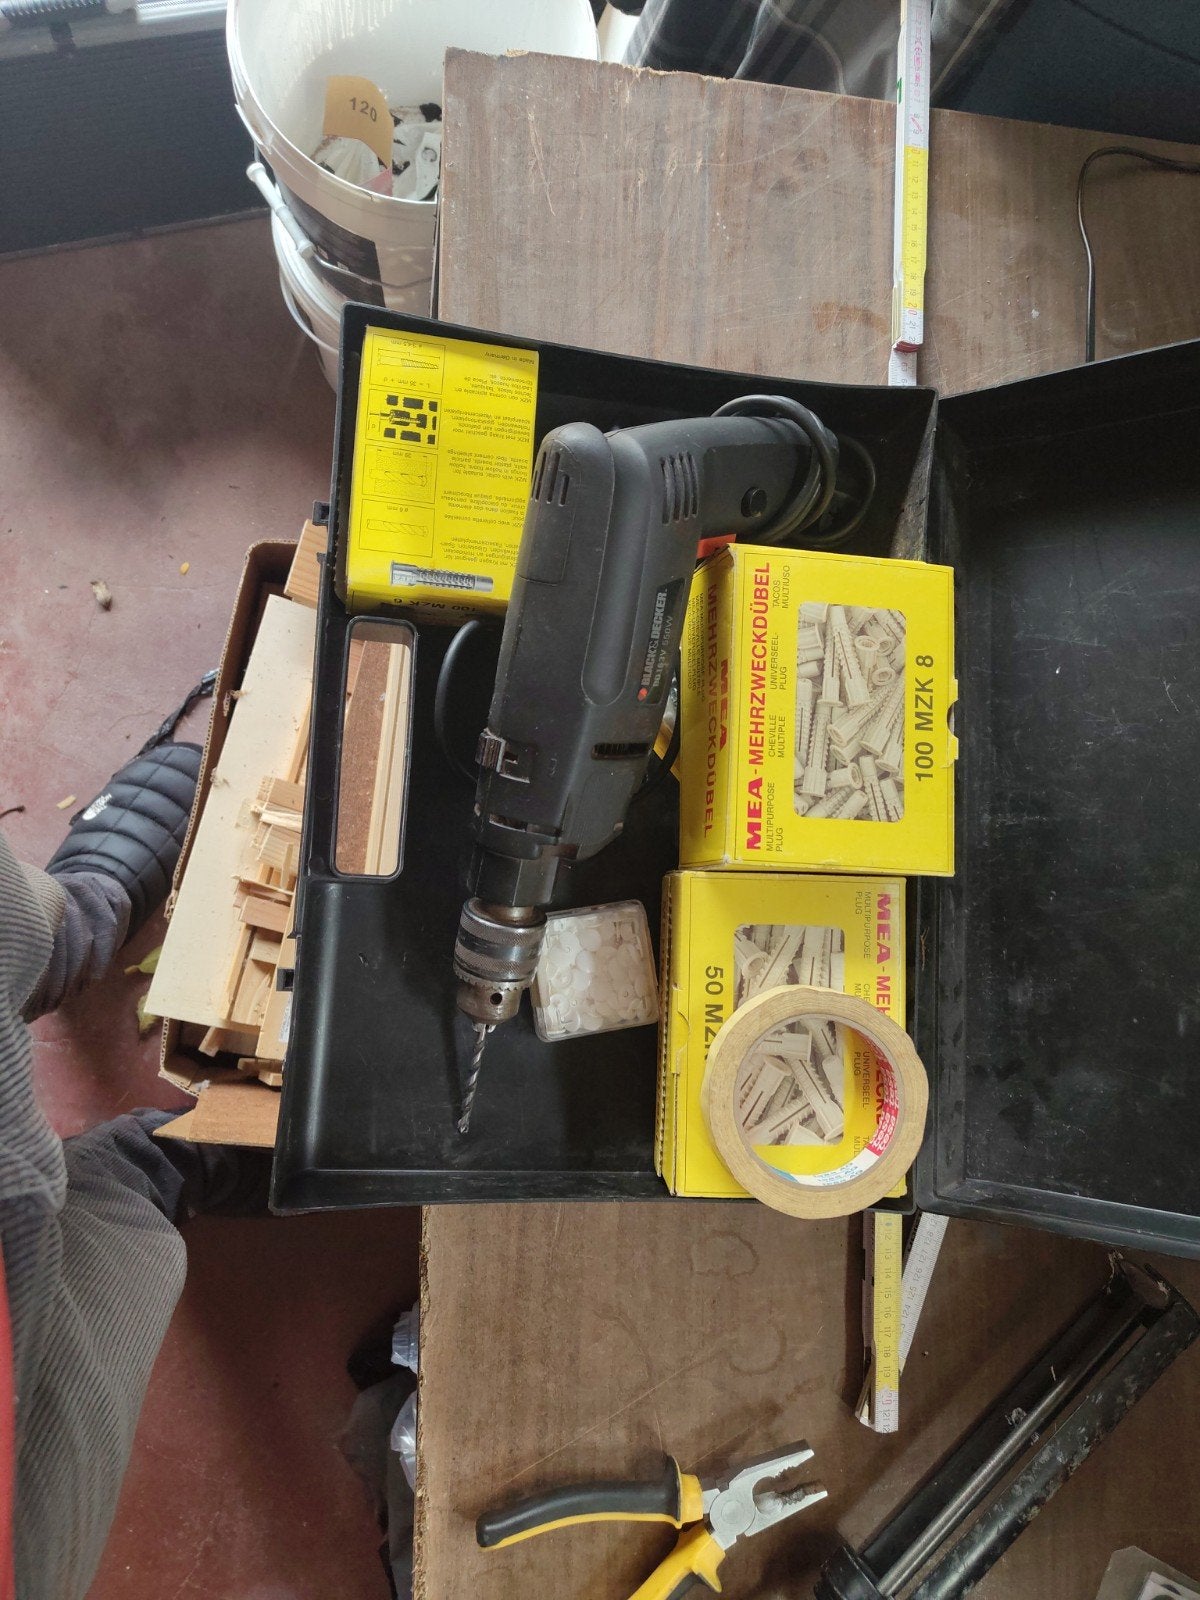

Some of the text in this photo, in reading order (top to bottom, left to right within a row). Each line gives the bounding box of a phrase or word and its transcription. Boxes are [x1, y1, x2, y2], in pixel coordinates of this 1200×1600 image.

[349, 97, 377, 122] 120
[912, 176, 919, 184] 12
[912, 192, 918, 200] 13
[912, 208, 918, 216] 14
[911, 224, 918, 232] 15
[910, 240, 918, 248] 16
[910, 272, 918, 281] 18
[910, 288, 917, 297] 19
[908, 302, 918, 316] 20
[484, 352, 511, 361] Germany
[518, 357, 535, 365] Made
[782, 564, 790, 609] MULTIUSO
[772, 579, 781, 609] TACOS
[409, 600, 446, 609] MZK
[779, 666, 787, 690] PLUG
[704, 584, 718, 839] MEHRZWECKDÜBEL
[720, 659, 729, 751] MEA
[915, 654, 934, 782] 100 MZK 8
[768, 714, 776, 758] CHEVILLE
[777, 715, 786, 758] MULTIPLE
[746, 777, 763, 850] MEA
[766, 782, 775, 852] MULTIPURPOSE
[776, 828, 784, 852] PLUG
[876, 894, 891, 964] MEA
[706, 966, 724, 996] 50
[884, 1248, 893, 1260] 113
[884, 1268, 893, 1279] 114
[912, 1268, 922, 1282] 126
[884, 1286, 893, 1299] 115
[904, 1286, 916, 1301] 125
[884, 1306, 893, 1318] 116
[902, 1304, 911, 1320] 124
[884, 1326, 893, 1337] 117
[884, 1345, 892, 1358] 118
[884, 1364, 892, 1378] 119
[882, 1408, 891, 1421] 121
